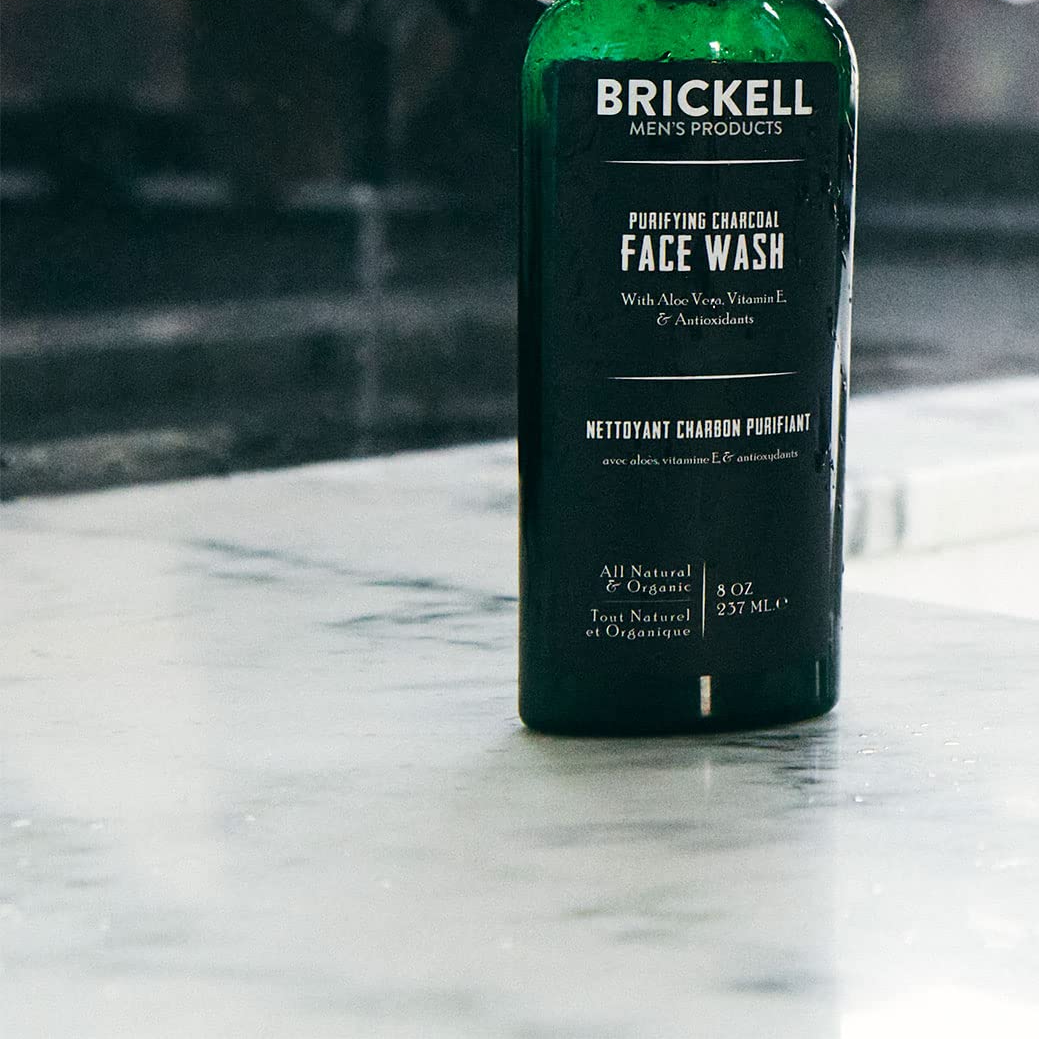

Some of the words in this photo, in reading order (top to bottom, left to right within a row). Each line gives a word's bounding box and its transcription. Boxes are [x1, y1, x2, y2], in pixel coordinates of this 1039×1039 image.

[597, 79, 813, 117] BRICKELL
[629, 121, 686, 136] MEN'S
[690, 120, 783, 136] PRODUCTS
[629, 212, 706, 230] PURIFYING
[712, 210, 779, 229] CHARCOAL
[621, 234, 692, 272] FACE
[705, 232, 785, 271] WASH
[621, 292, 654, 306] With
[657, 292, 689, 306] Aloe
[727, 291, 774, 305] Vitamin
[656, 312, 672, 326] &
[674, 311, 755, 326] Antioxidants
[586, 420, 670, 439] NETTOYANT
[676, 418, 741, 439] CHARBON
[746, 413, 811, 437] PURIFIANT
[602, 457, 627, 466] avec
[662, 455, 710, 466] vitamine
[711, 452, 721, 464] E
[722, 451, 734, 463] &
[736, 448, 799, 465] antioxydants
[600, 564, 624, 579] All
[631, 563, 692, 579] Natural
[606, 579, 622, 593] &
[627, 579, 692, 596] Organic
[716, 583, 726, 598] 8
[730, 581, 754, 596] OZ
[590, 608, 624, 623] Tout
[630, 608, 691, 623] Naturel
[716, 601, 746, 617] 237
[585, 628, 600, 638] et
[606, 624, 691, 641] Organique
